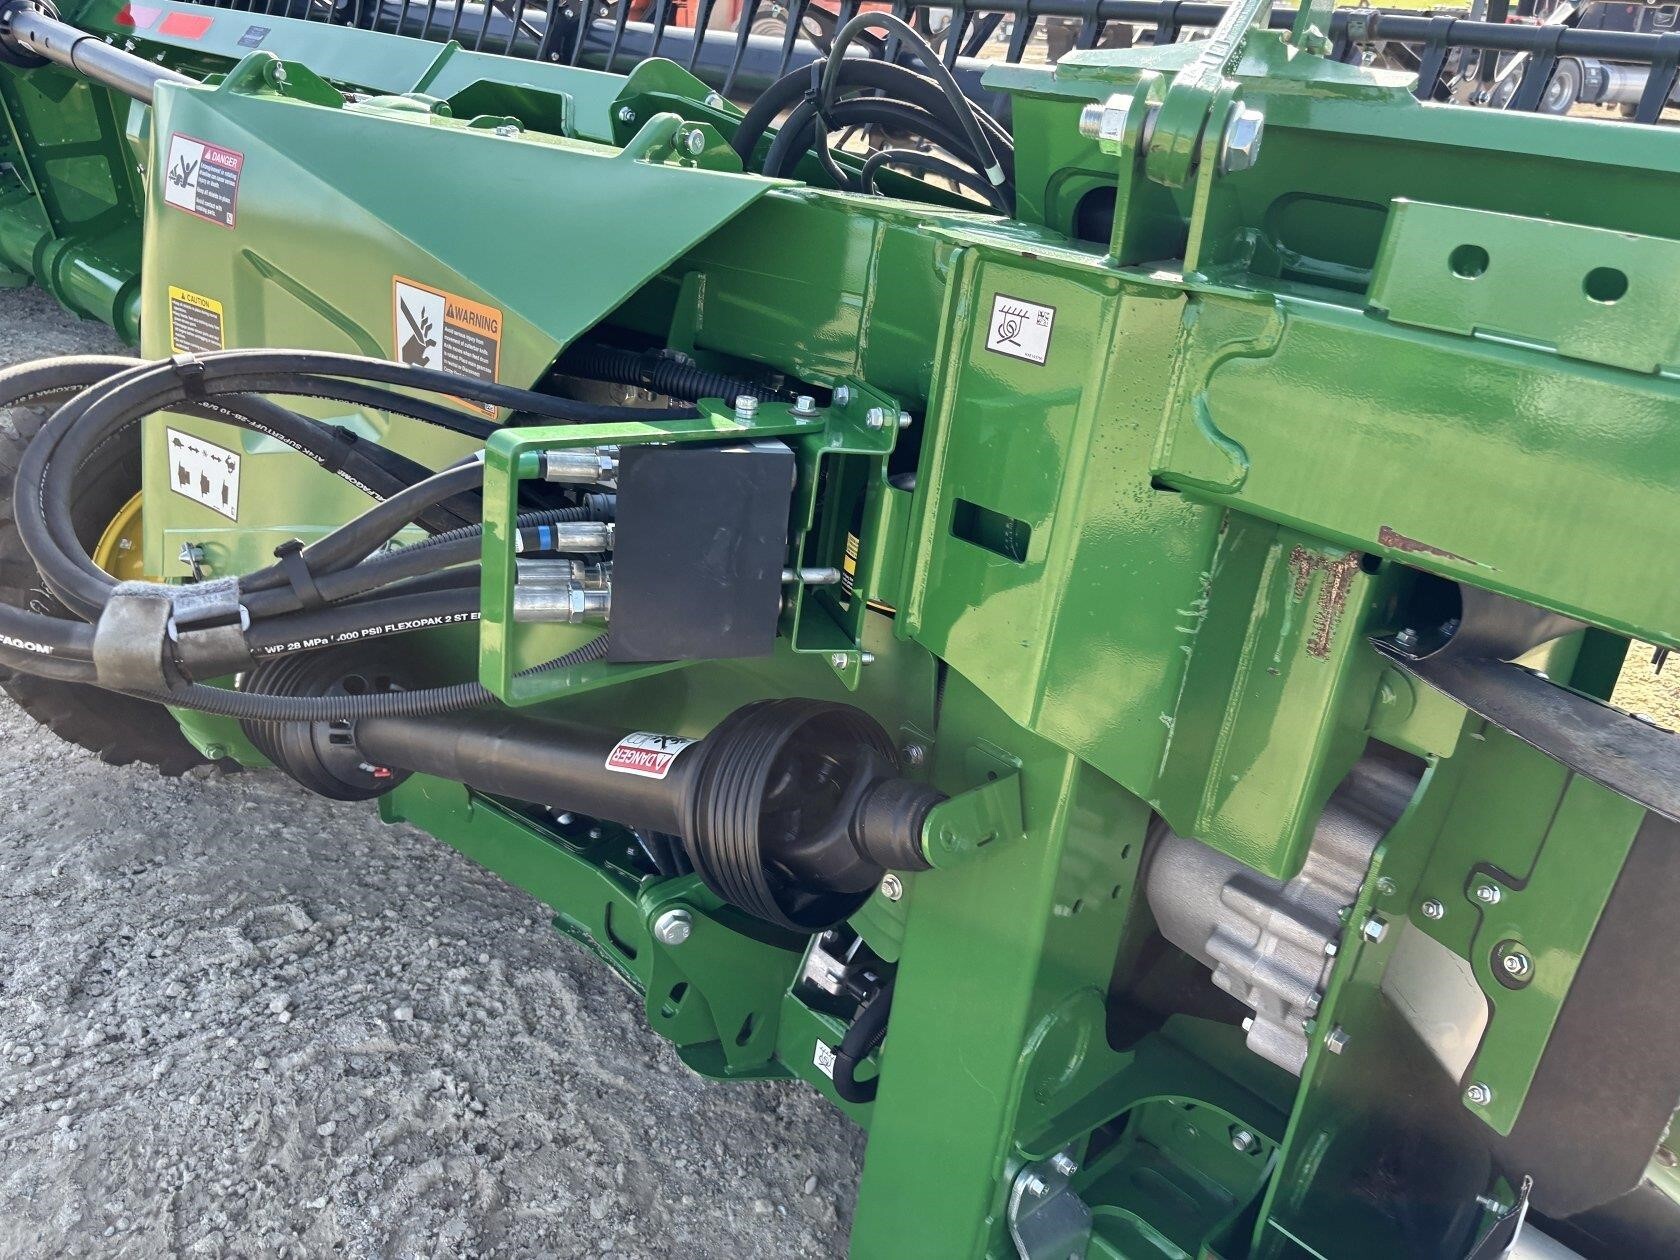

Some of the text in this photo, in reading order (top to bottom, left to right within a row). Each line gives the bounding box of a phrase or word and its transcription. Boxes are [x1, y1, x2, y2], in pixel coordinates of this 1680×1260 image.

[212, 152, 238, 168] DANGER
[186, 295, 210, 308] CAUTION
[454, 306, 498, 334] WARNING
[302, 447, 325, 462] AT4K
[264, 645, 284, 654] WP
[287, 642, 301, 650] 28
[303, 638, 328, 648] MPa
[362, 626, 382, 637] PSI)
[385, 617, 443, 632] FLEXOPAK
[454, 614, 468, 622] ST
[612, 748, 657, 766] DANGER
